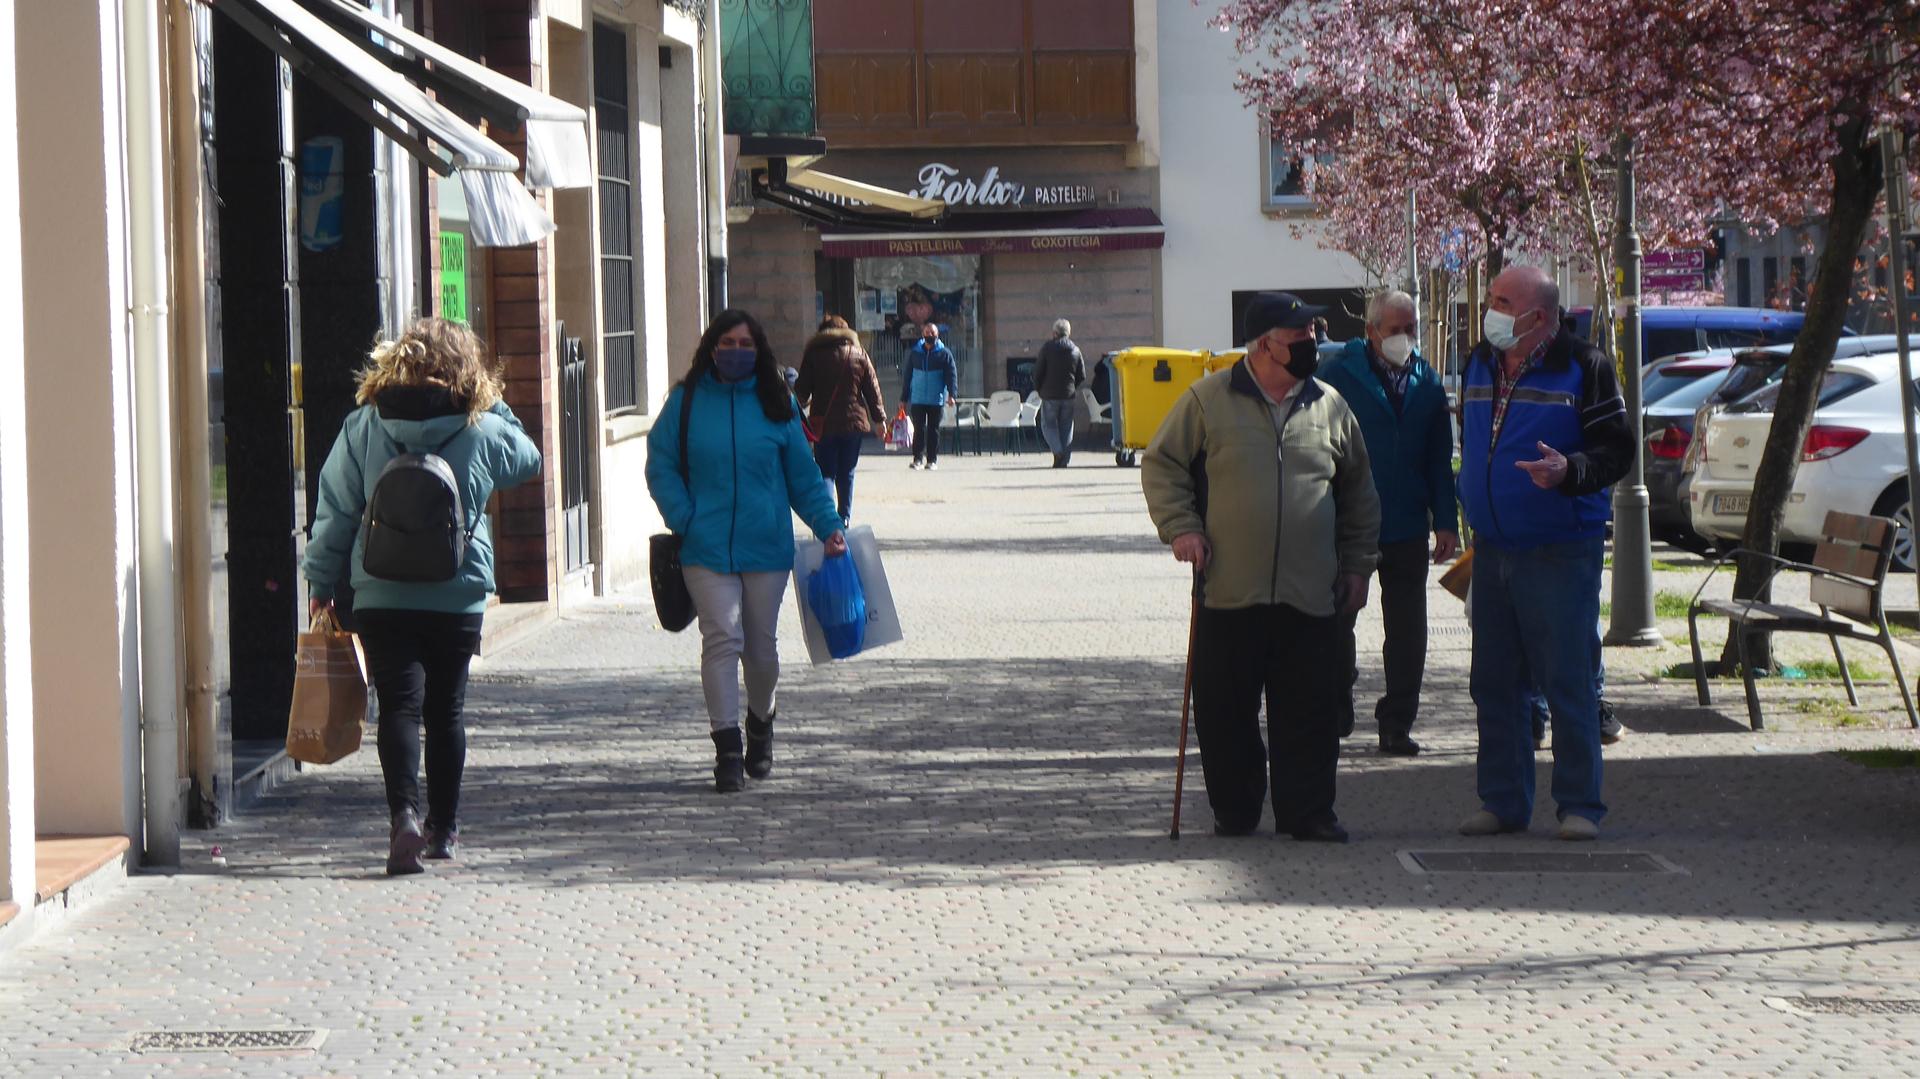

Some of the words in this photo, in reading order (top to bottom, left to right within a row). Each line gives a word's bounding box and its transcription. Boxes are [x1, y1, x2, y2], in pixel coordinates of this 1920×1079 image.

[1035, 186, 1095, 204] PASTELERIA
[889, 240, 964, 254] PASTELERIA
[1031, 236, 1101, 249] GOXOTEGIA
